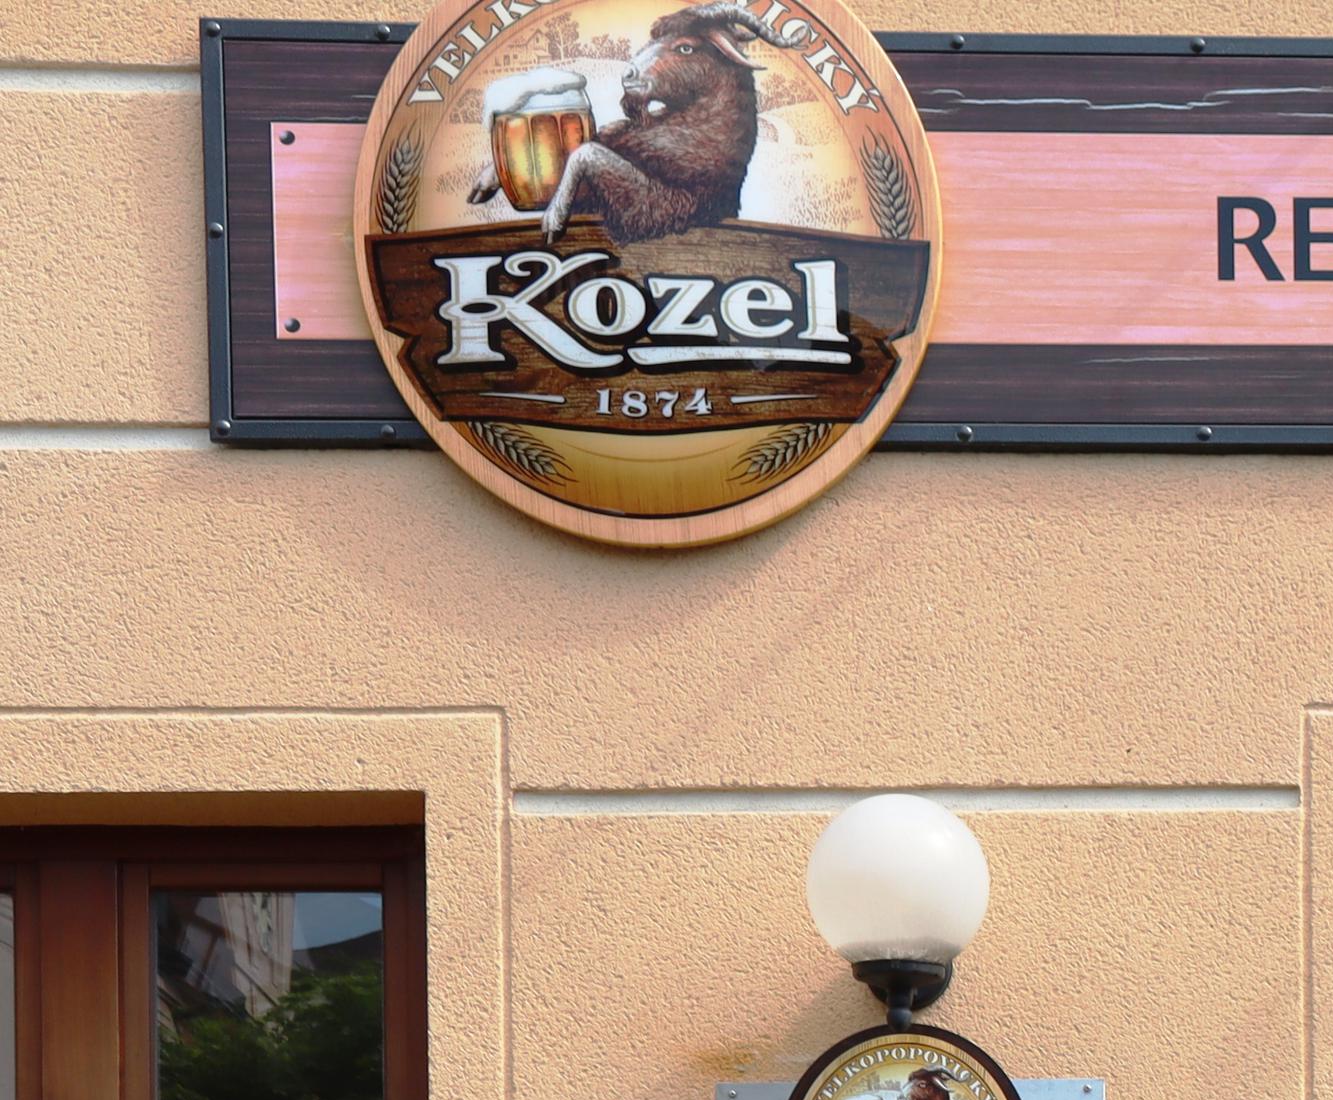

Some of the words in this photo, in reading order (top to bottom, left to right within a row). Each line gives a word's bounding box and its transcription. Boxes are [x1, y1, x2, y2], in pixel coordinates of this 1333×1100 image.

[407, 0, 881, 116] VELKICKÝ
[434, 250, 850, 368] Kozel
[595, 387, 714, 418] 1874
